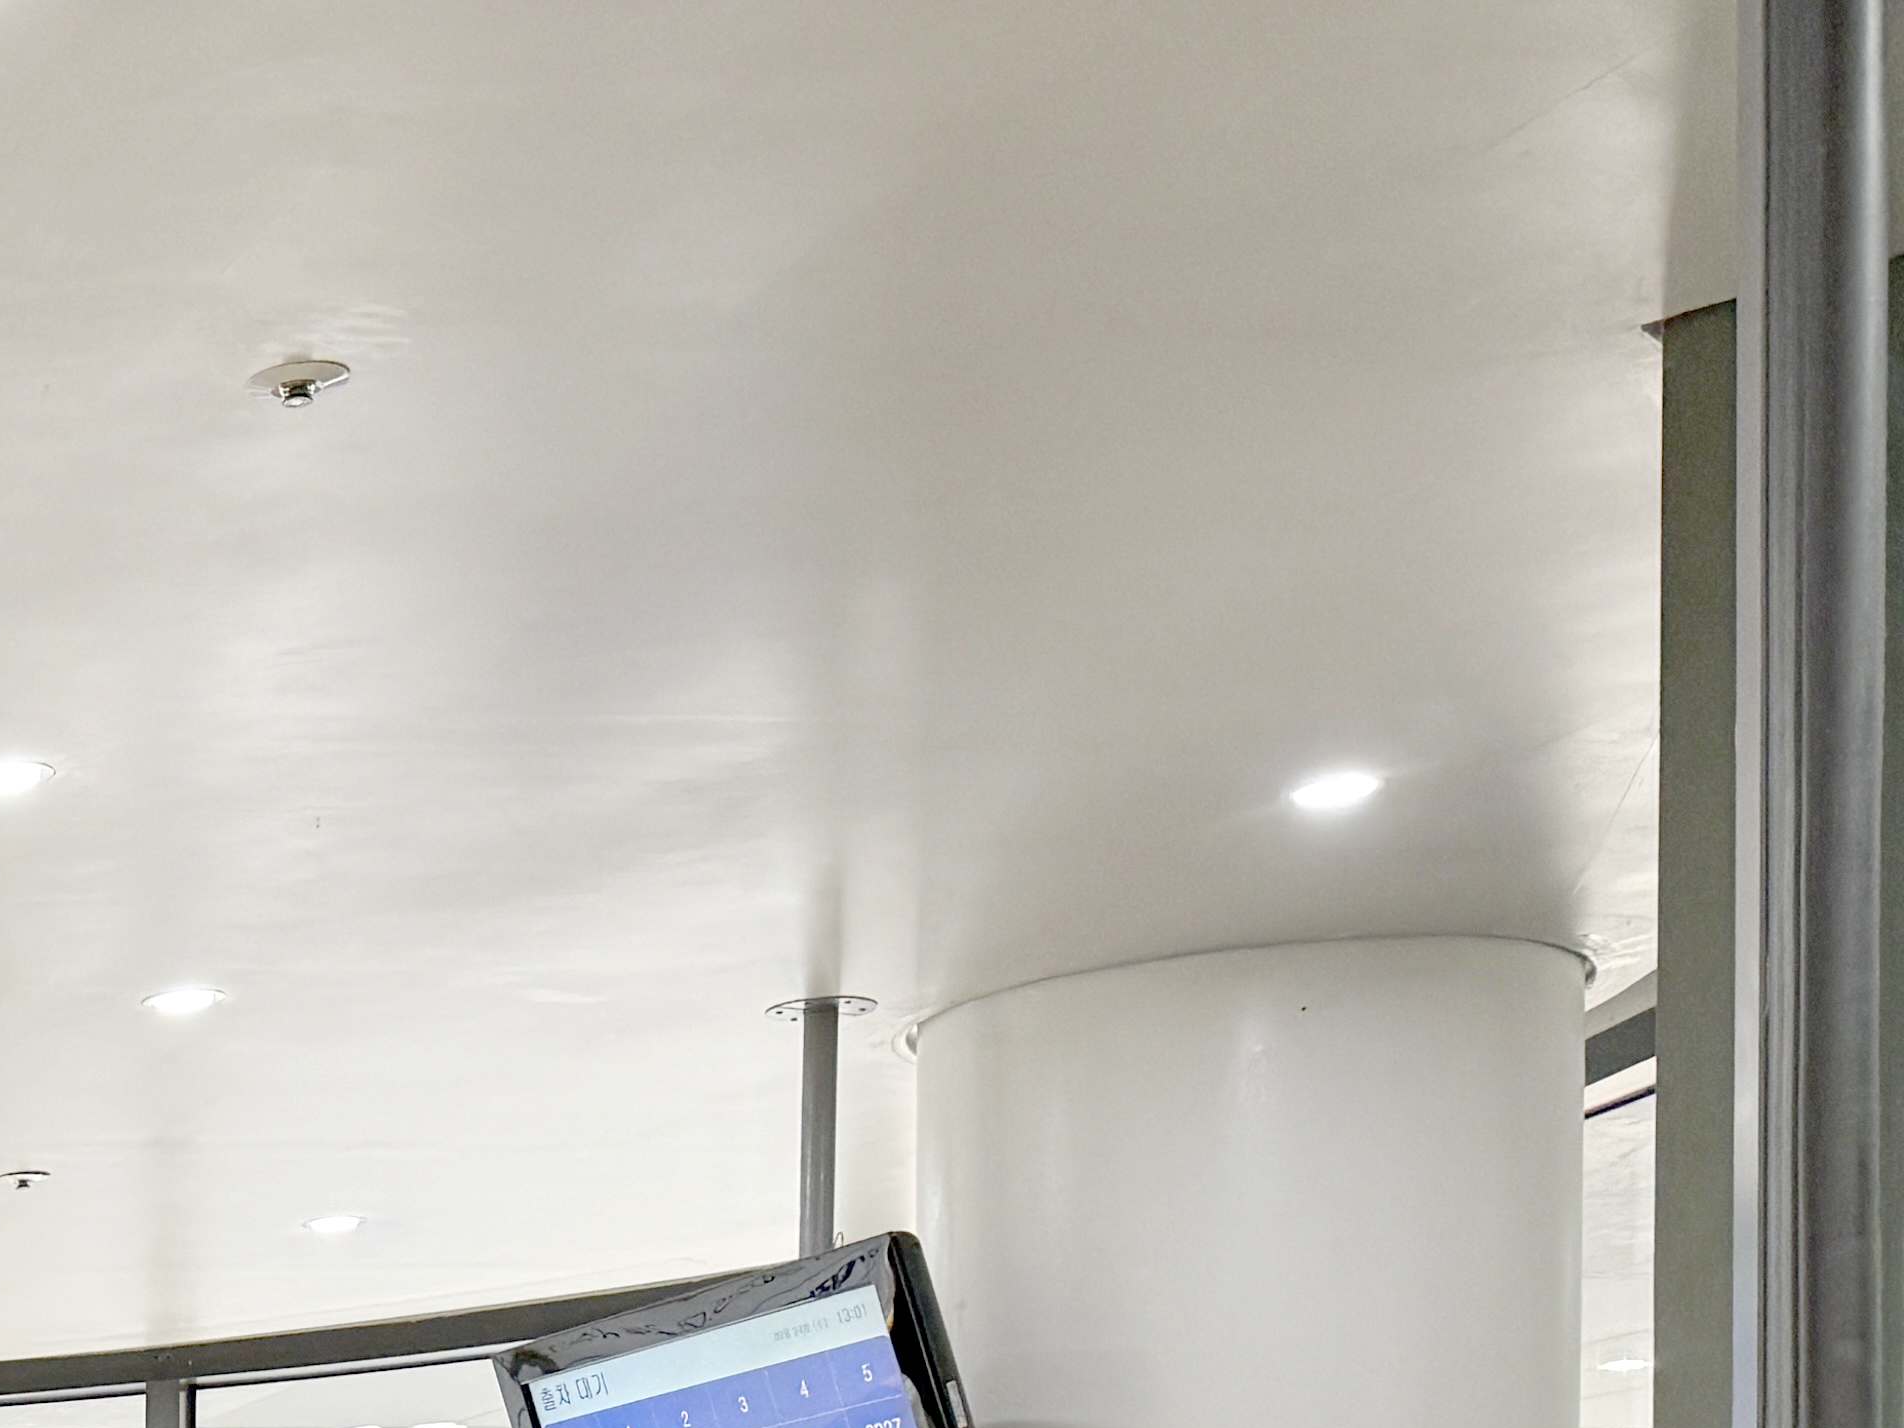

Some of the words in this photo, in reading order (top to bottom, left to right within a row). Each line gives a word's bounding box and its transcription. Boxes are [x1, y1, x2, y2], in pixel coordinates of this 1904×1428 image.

[541, 1381, 572, 1412] 출차
[576, 1371, 609, 1401] 대기
[836, 1303, 869, 1325] 13:01
[680, 1410, 692, 1428] 2
[737, 1396, 750, 1414] 3
[799, 1380, 810, 1398] 4
[861, 1363, 873, 1383] 5
